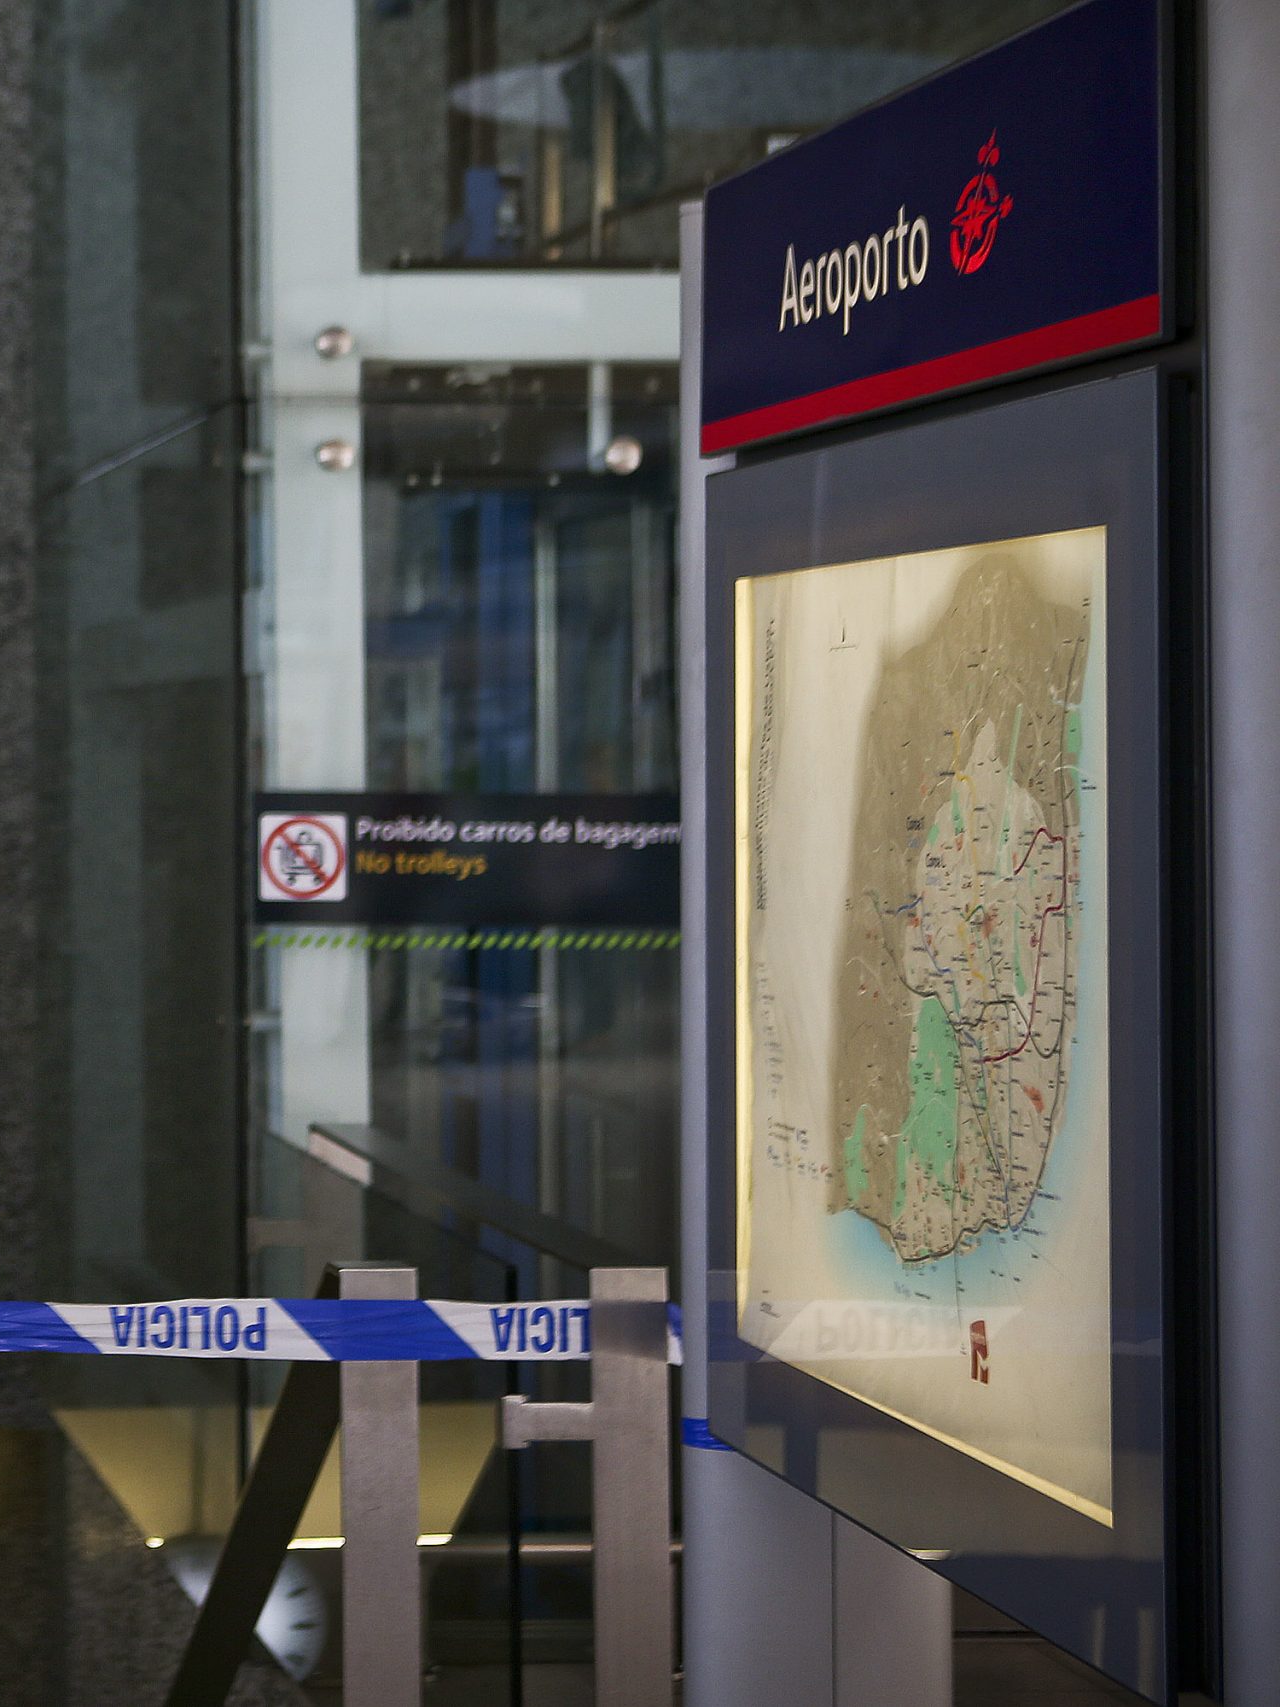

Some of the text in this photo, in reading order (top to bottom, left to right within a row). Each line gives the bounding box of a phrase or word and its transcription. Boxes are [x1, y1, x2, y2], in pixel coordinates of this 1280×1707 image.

[778, 203, 930, 336] Aeroporto
[354, 816, 456, 842] Proibido
[459, 821, 536, 843] carros
[539, 818, 569, 843] de
[355, 852, 488, 880] No trolleys
[108, 1306, 266, 1351] POLICIA
[490, 1307, 591, 1352] LICIA
